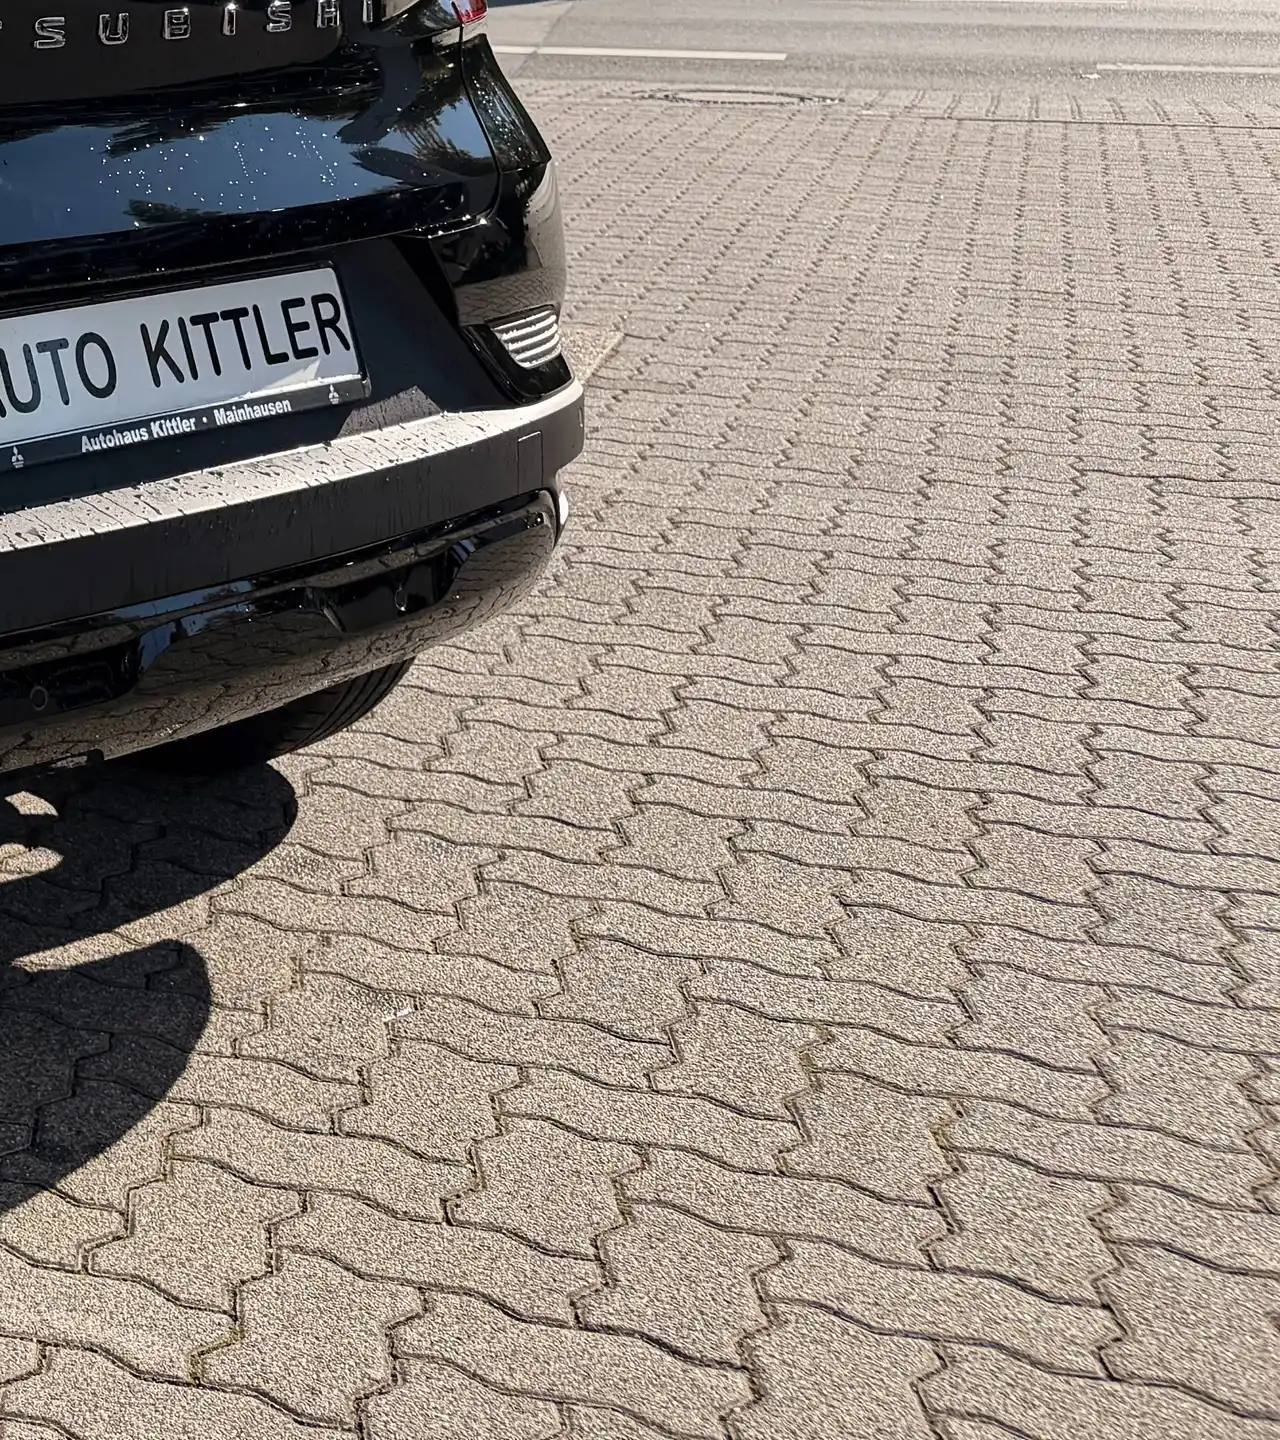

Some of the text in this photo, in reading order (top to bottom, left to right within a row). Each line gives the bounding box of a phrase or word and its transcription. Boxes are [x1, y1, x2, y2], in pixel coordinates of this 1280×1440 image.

[141, 293, 351, 388] KITTLER
[81, 399, 292, 453] Autohaus Kittler Mainhausen
